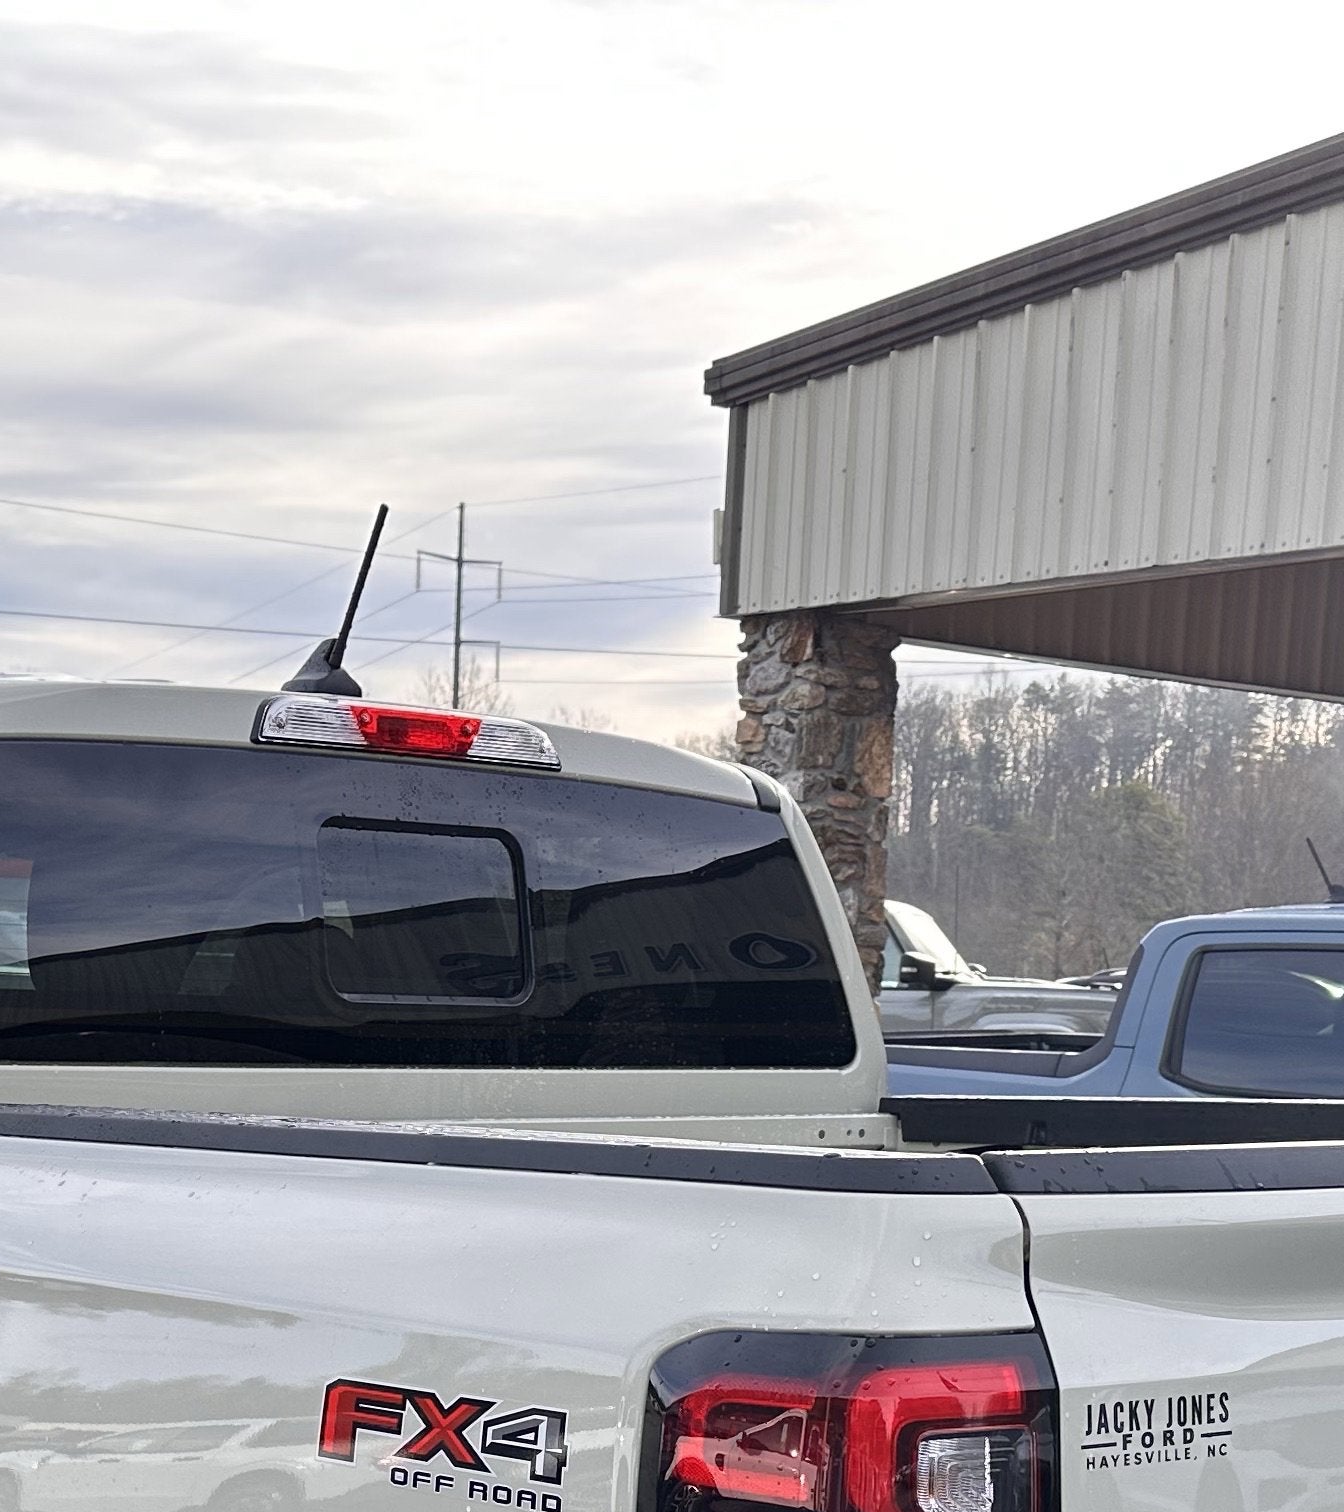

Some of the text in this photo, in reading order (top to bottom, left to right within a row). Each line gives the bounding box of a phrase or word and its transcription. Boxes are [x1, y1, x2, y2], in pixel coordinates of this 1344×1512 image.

[1085, 1391, 1229, 1436] JACKY JONES
[316, 1377, 569, 1487] FX4
[1122, 1427, 1195, 1451] FORD
[1086, 1443, 1228, 1470] HAYESVILLE, NC
[390, 1467, 454, 1492] OFF
